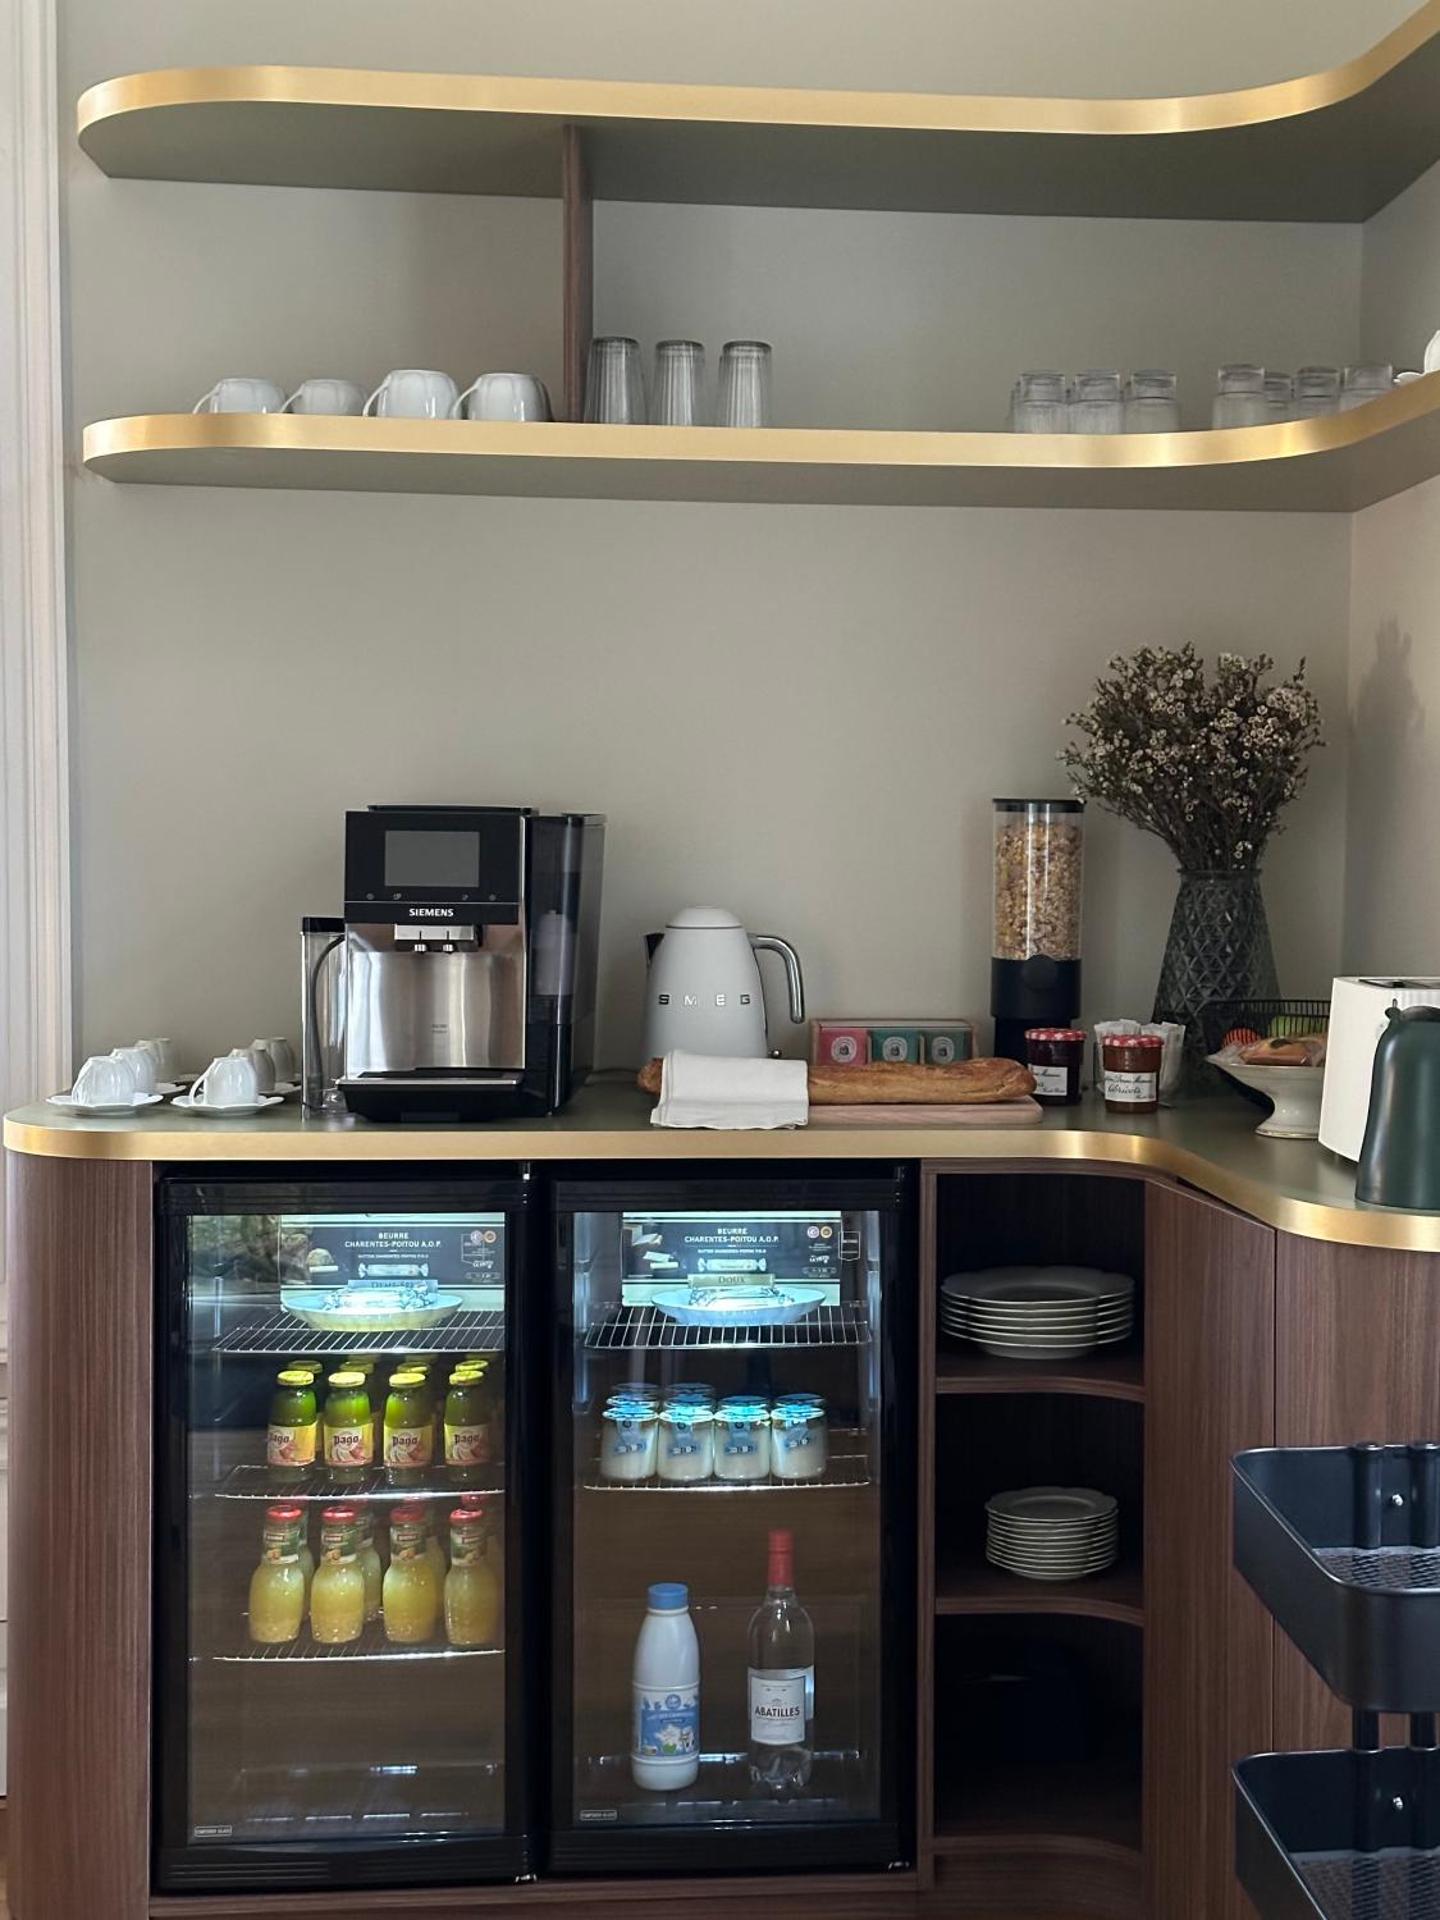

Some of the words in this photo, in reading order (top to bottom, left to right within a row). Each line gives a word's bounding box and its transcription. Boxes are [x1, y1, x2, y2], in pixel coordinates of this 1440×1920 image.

[409, 908, 454, 917] SIEMENS
[658, 993, 751, 1005] SMEG
[717, 1227, 748, 1235] BEURRE
[378, 1232, 409, 1240] BEURRE
[684, 1235, 757, 1243] CHARENTES-POITOU
[344, 1240, 420, 1248] CHARENTES-POITOU
[755, 1705, 801, 1717] ABATILLES
